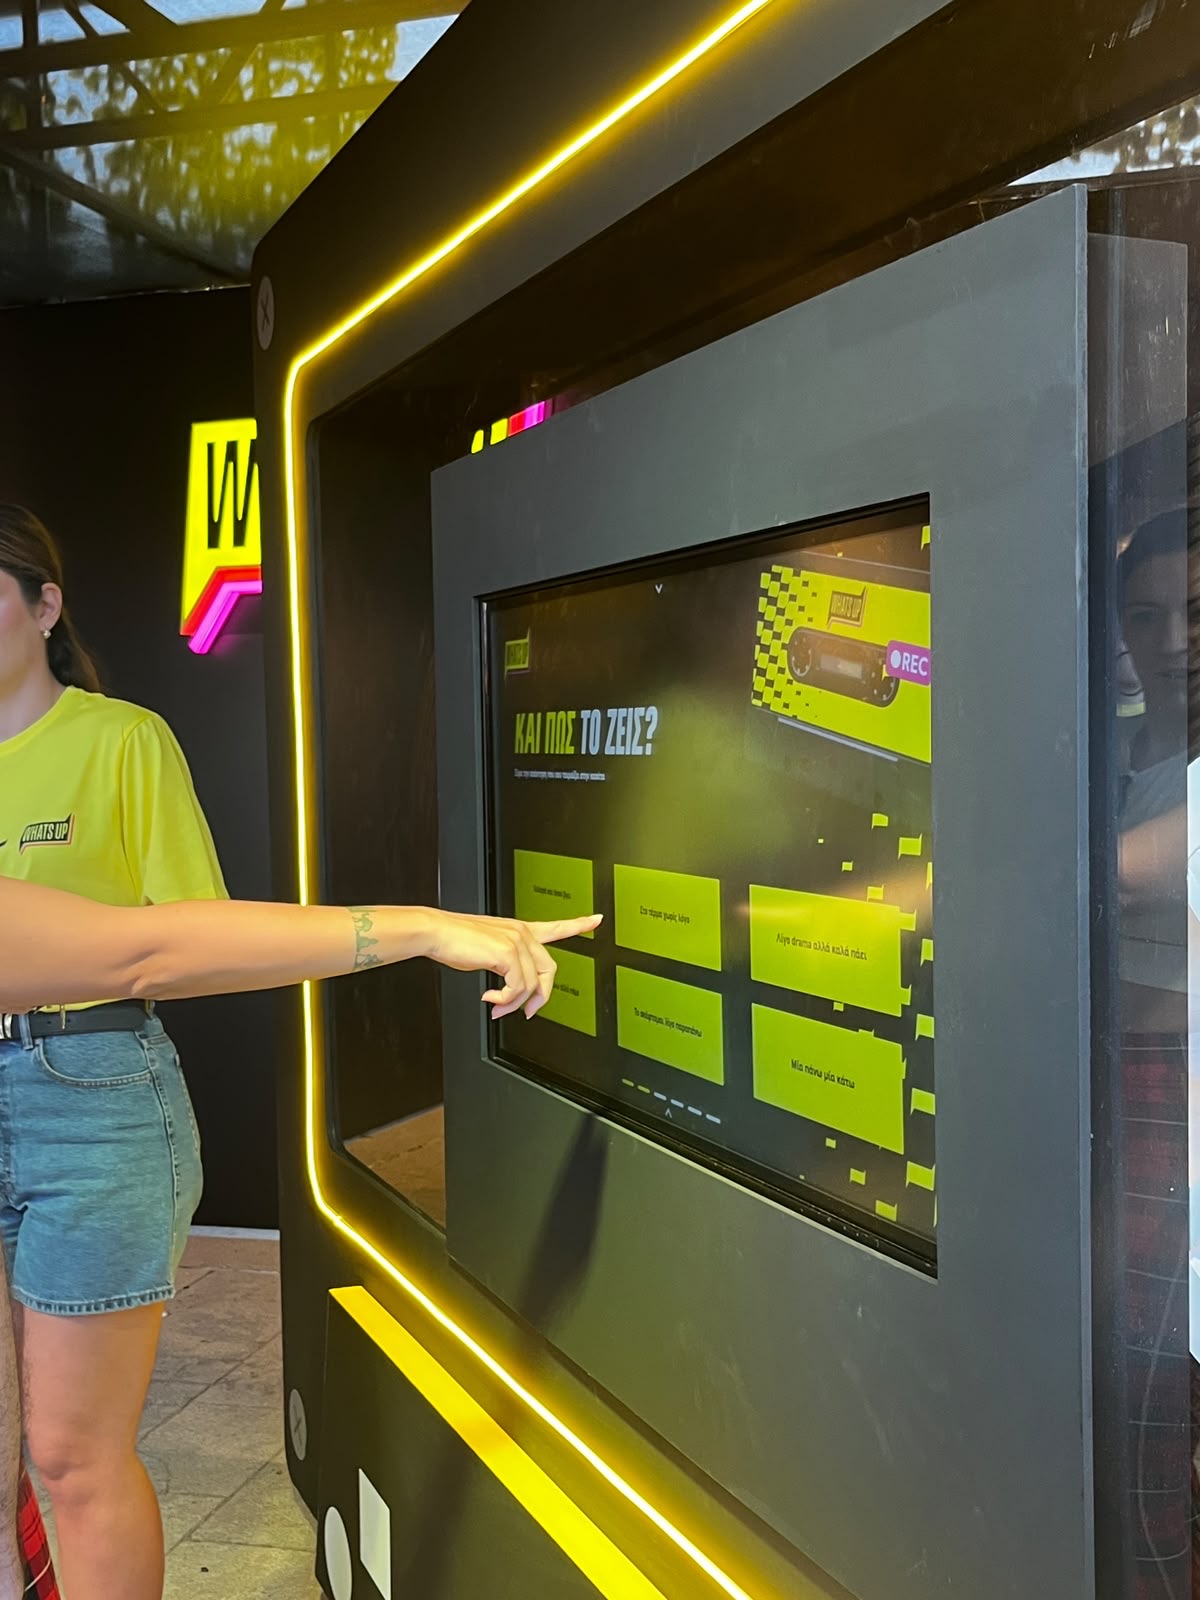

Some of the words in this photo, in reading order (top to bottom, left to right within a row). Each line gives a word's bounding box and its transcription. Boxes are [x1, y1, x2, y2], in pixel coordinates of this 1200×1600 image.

[831, 593, 853, 617] WHATS
[852, 597, 862, 619] UP
[902, 651, 929, 677] REC
[514, 712, 542, 754] ΚΑΙ
[545, 710, 577, 755] ΠΩΣ
[580, 708, 601, 756] ΤΟ
[604, 706, 658, 756] ΖΕΙΣ?
[22, 823, 55, 842] WHATS
[55, 822, 69, 840] UP
[776, 932, 790, 947] Λίγο
[791, 936, 812, 950] drama
[813, 940, 831, 953] αλλά
[832, 944, 849, 957] καλά
[850, 947, 868, 961] πάει
[791, 1058, 804, 1072] Μία
[804, 1063, 823, 1078] πάνω
[823, 1069, 836, 1083] μία
[836, 1074, 855, 1089] κάτω
